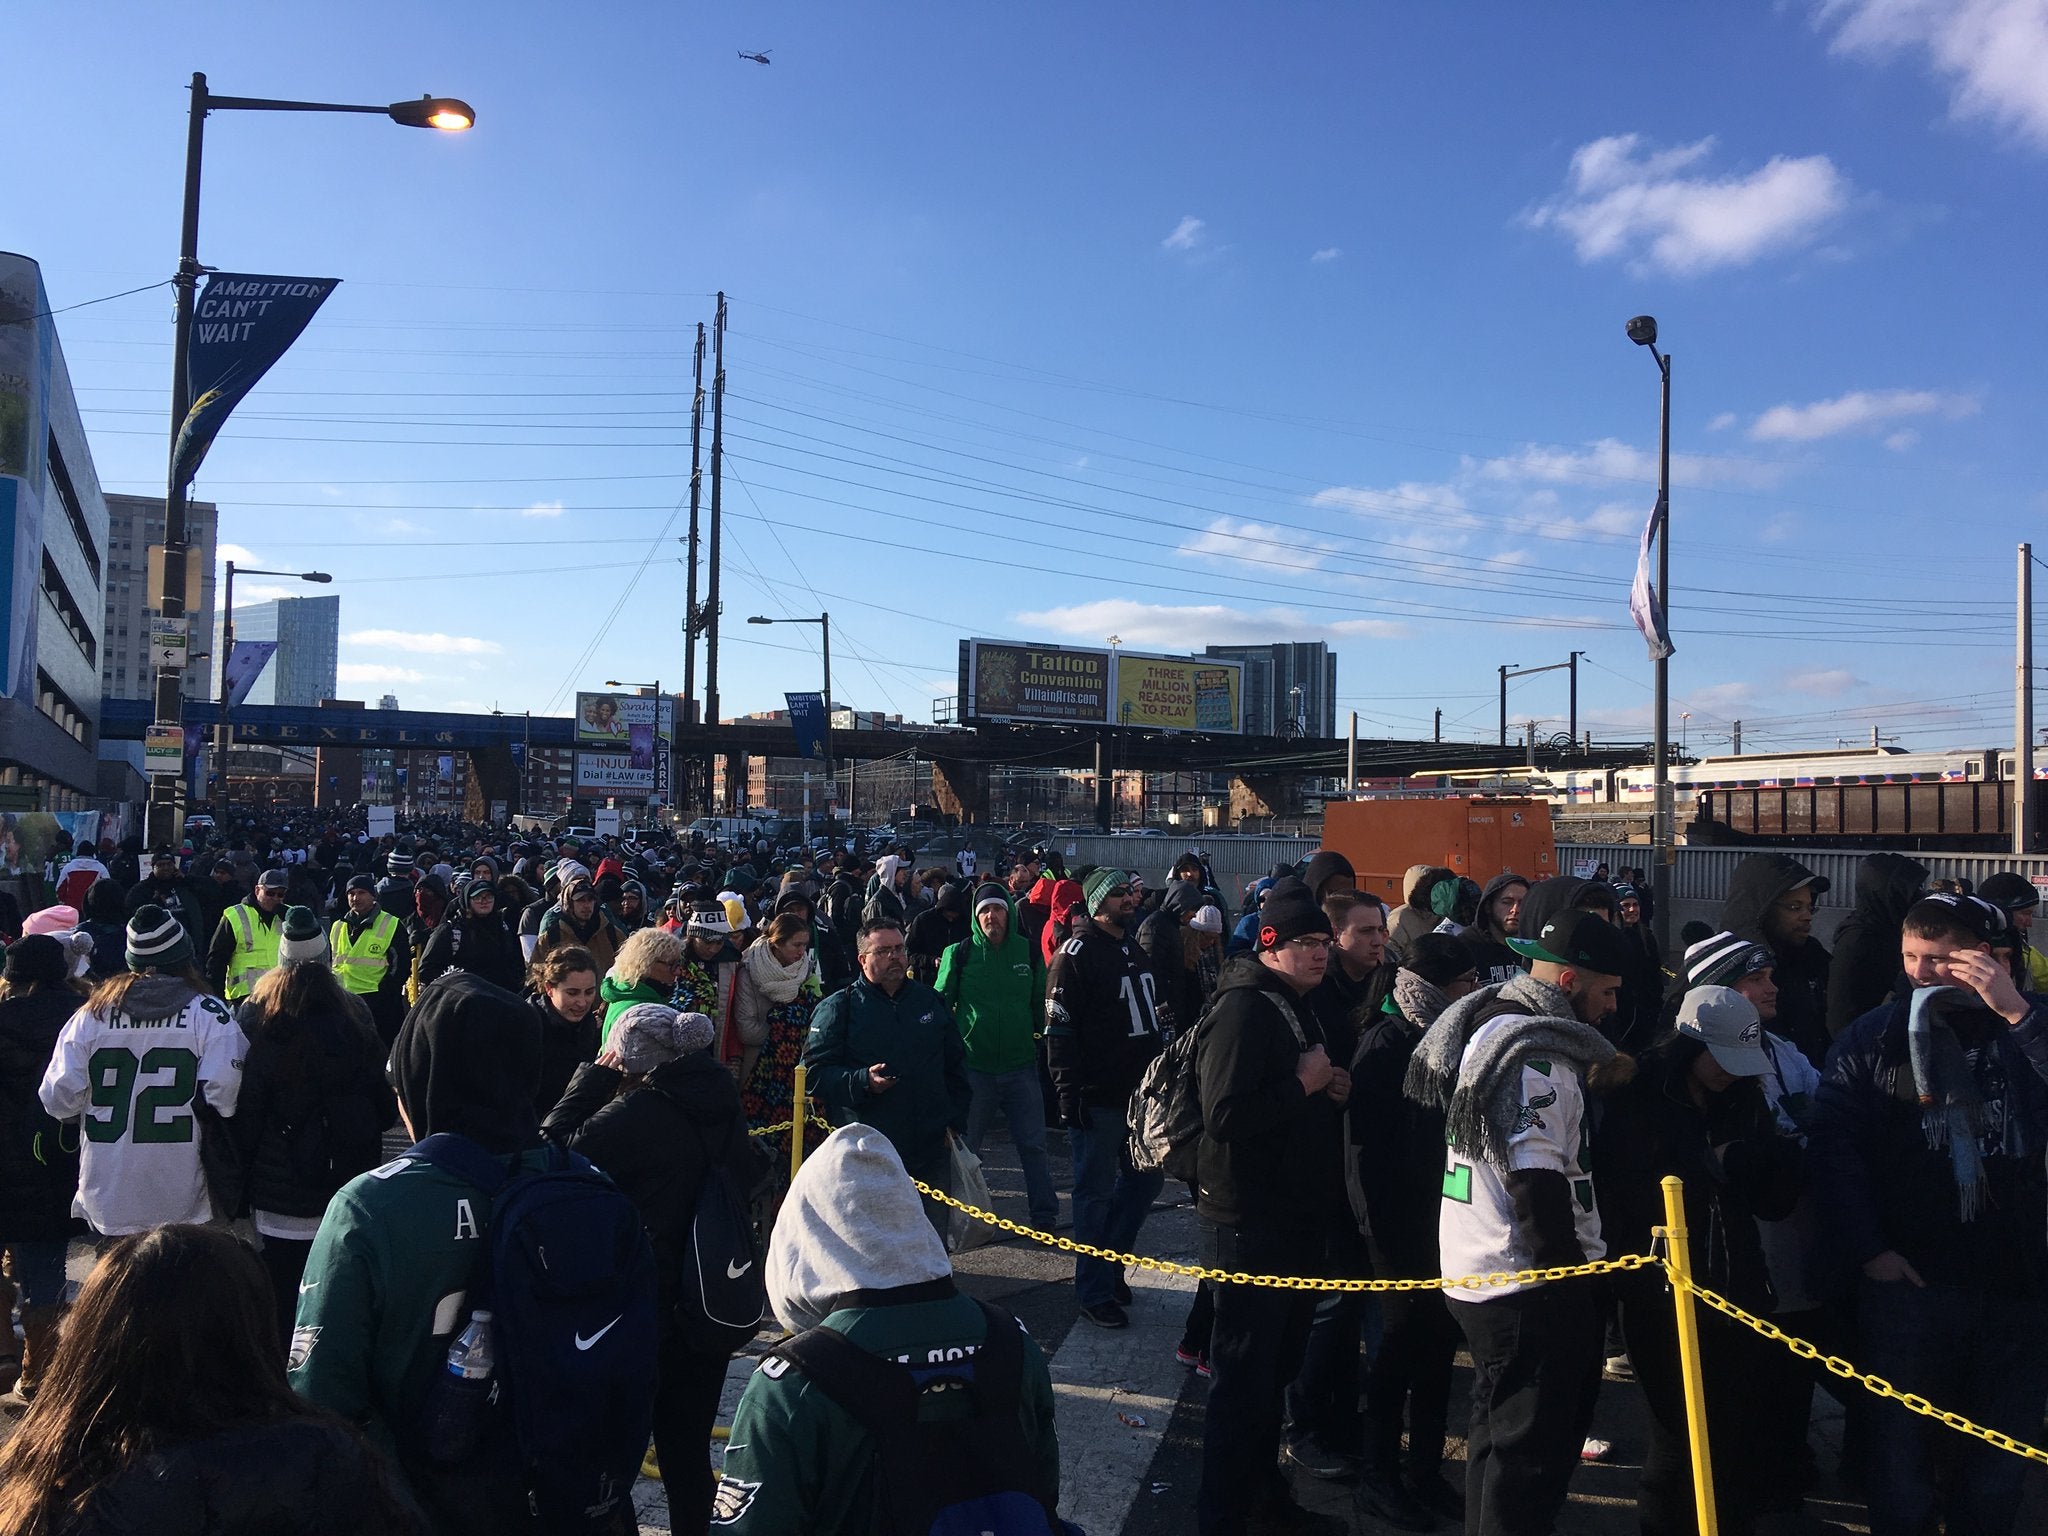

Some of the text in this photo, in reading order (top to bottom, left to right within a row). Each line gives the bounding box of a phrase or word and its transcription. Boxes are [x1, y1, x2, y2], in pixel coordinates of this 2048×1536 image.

[208, 280, 326, 299] AMBITION
[200, 299, 273, 318] CAN'T
[198, 322, 256, 344] WAIT
[1026, 651, 1098, 674] Tattoo
[1020, 671, 1102, 689] Convention
[1147, 667, 1185, 679] THREE
[1142, 679, 1190, 692] MILLION
[1024, 687, 1098, 706] VillainArts.com
[1138, 691, 1193, 705] REASONS
[619, 701, 671, 713] SarahCre
[1141, 703, 1189, 717] TO PLAY
[583, 770, 603, 779] Dial
[605, 771, 634, 780] #LAW
[658, 753, 667, 788] PARK
[690, 912, 725, 924] AGL
[1058, 938, 1083, 955] 10
[1118, 971, 1158, 1037] 10
[84, 1047, 198, 1143] 92
